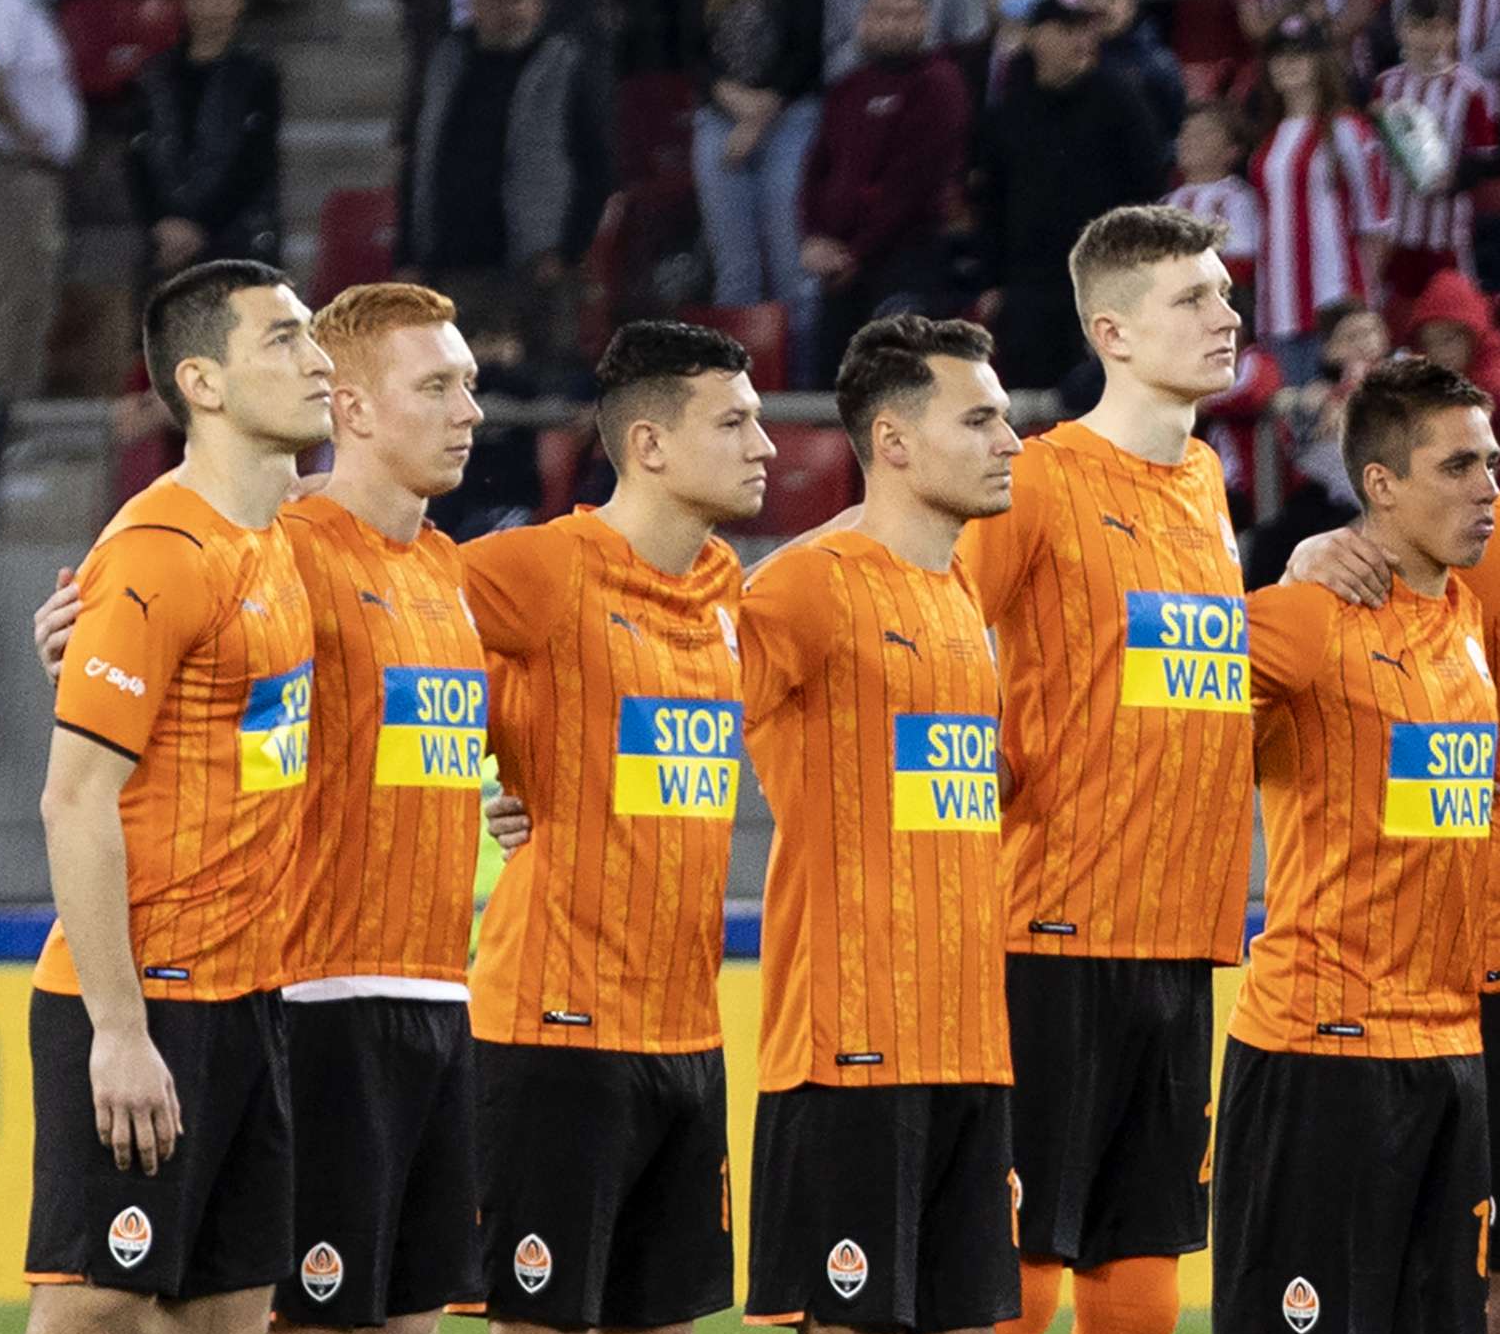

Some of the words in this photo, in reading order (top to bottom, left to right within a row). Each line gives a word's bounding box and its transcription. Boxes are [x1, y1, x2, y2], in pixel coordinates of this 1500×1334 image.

[1160, 602, 1245, 649] STOP
[105, 667, 146, 698] SkyUp
[417, 676, 484, 724] STOP
[1163, 657, 1244, 701] WAR
[654, 707, 735, 753] STOP
[927, 722, 998, 768] STOP
[421, 734, 482, 778] WAR
[1427, 731, 1493, 776] STOP
[931, 779, 997, 821] WAR
[1429, 787, 1492, 827] WAR
